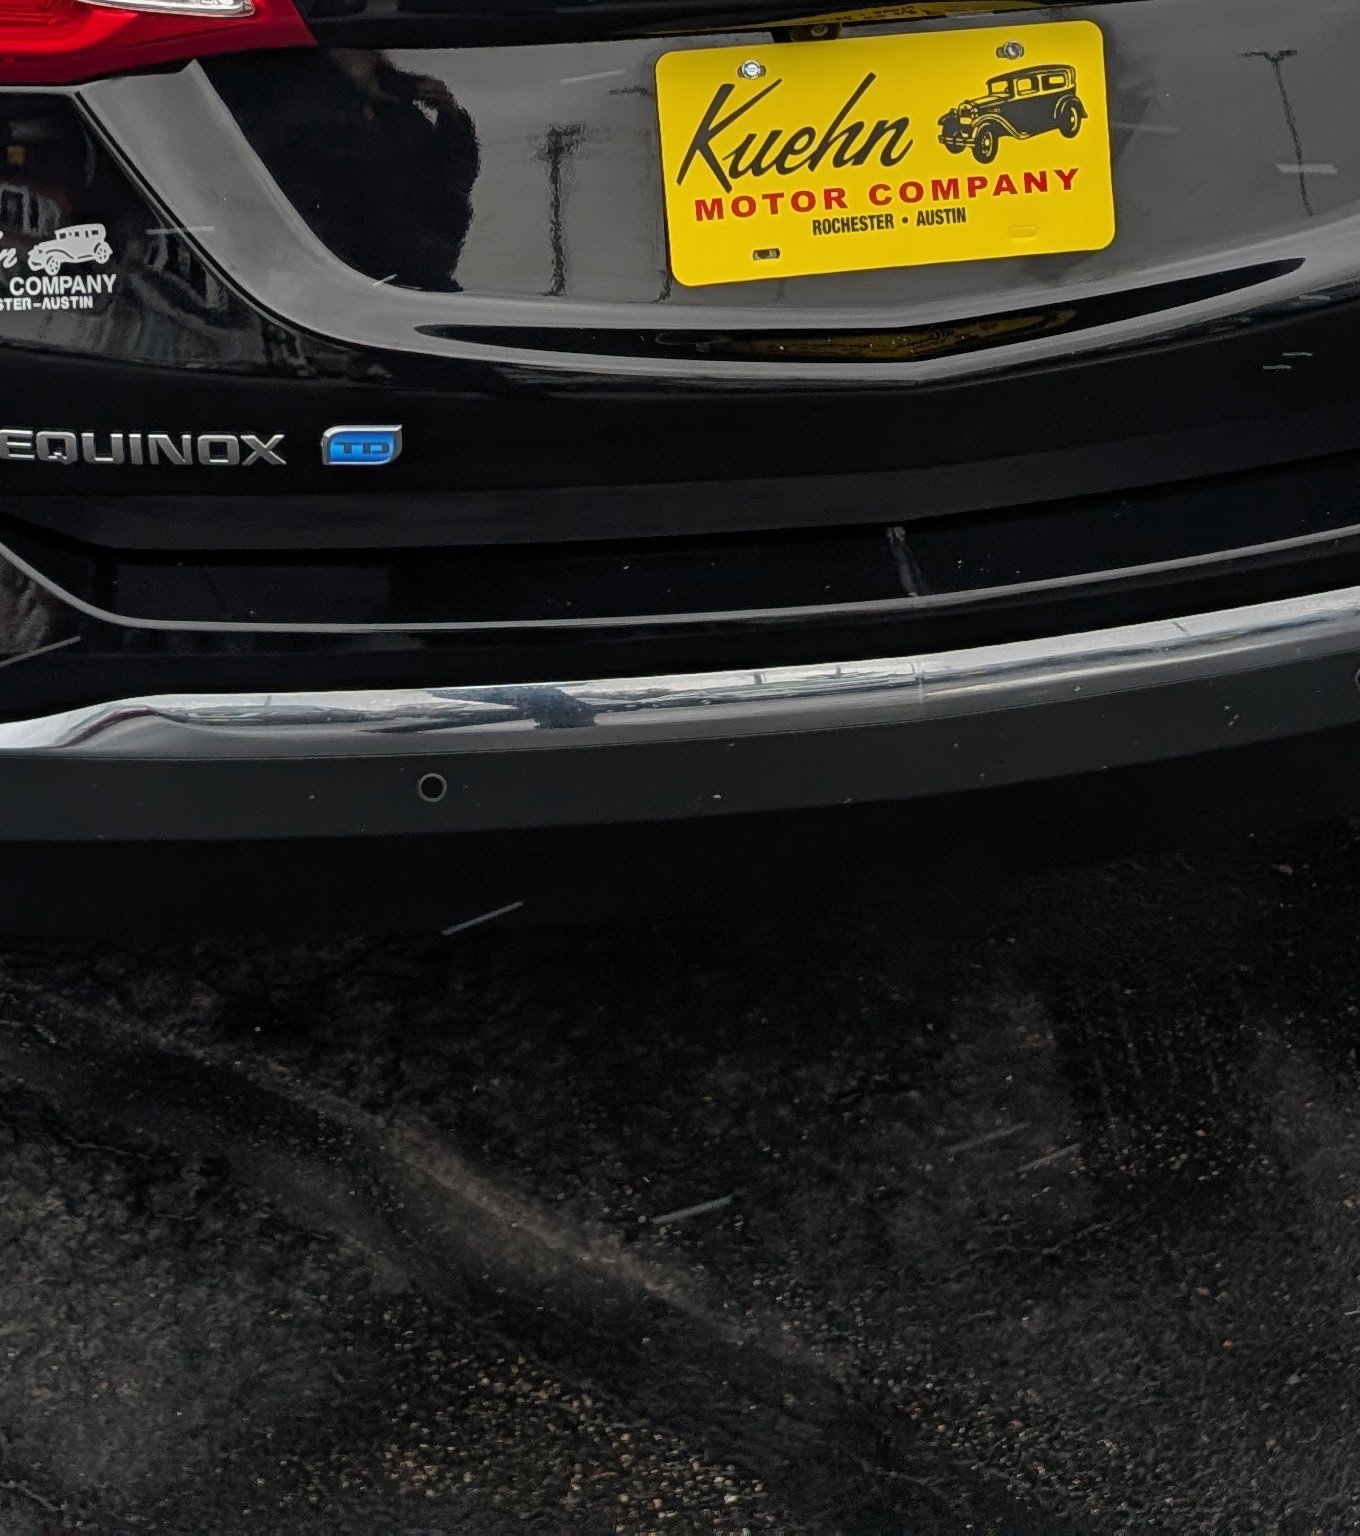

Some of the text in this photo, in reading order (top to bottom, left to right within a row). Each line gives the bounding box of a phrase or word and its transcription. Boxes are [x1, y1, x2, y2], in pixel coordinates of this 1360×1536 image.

[676, 72, 914, 194] Kuehn
[694, 167, 1080, 222] MOTOR COMPANY
[811, 207, 967, 236] ROCHESTER AUSTIN
[9, 273, 117, 296] COMPANY
